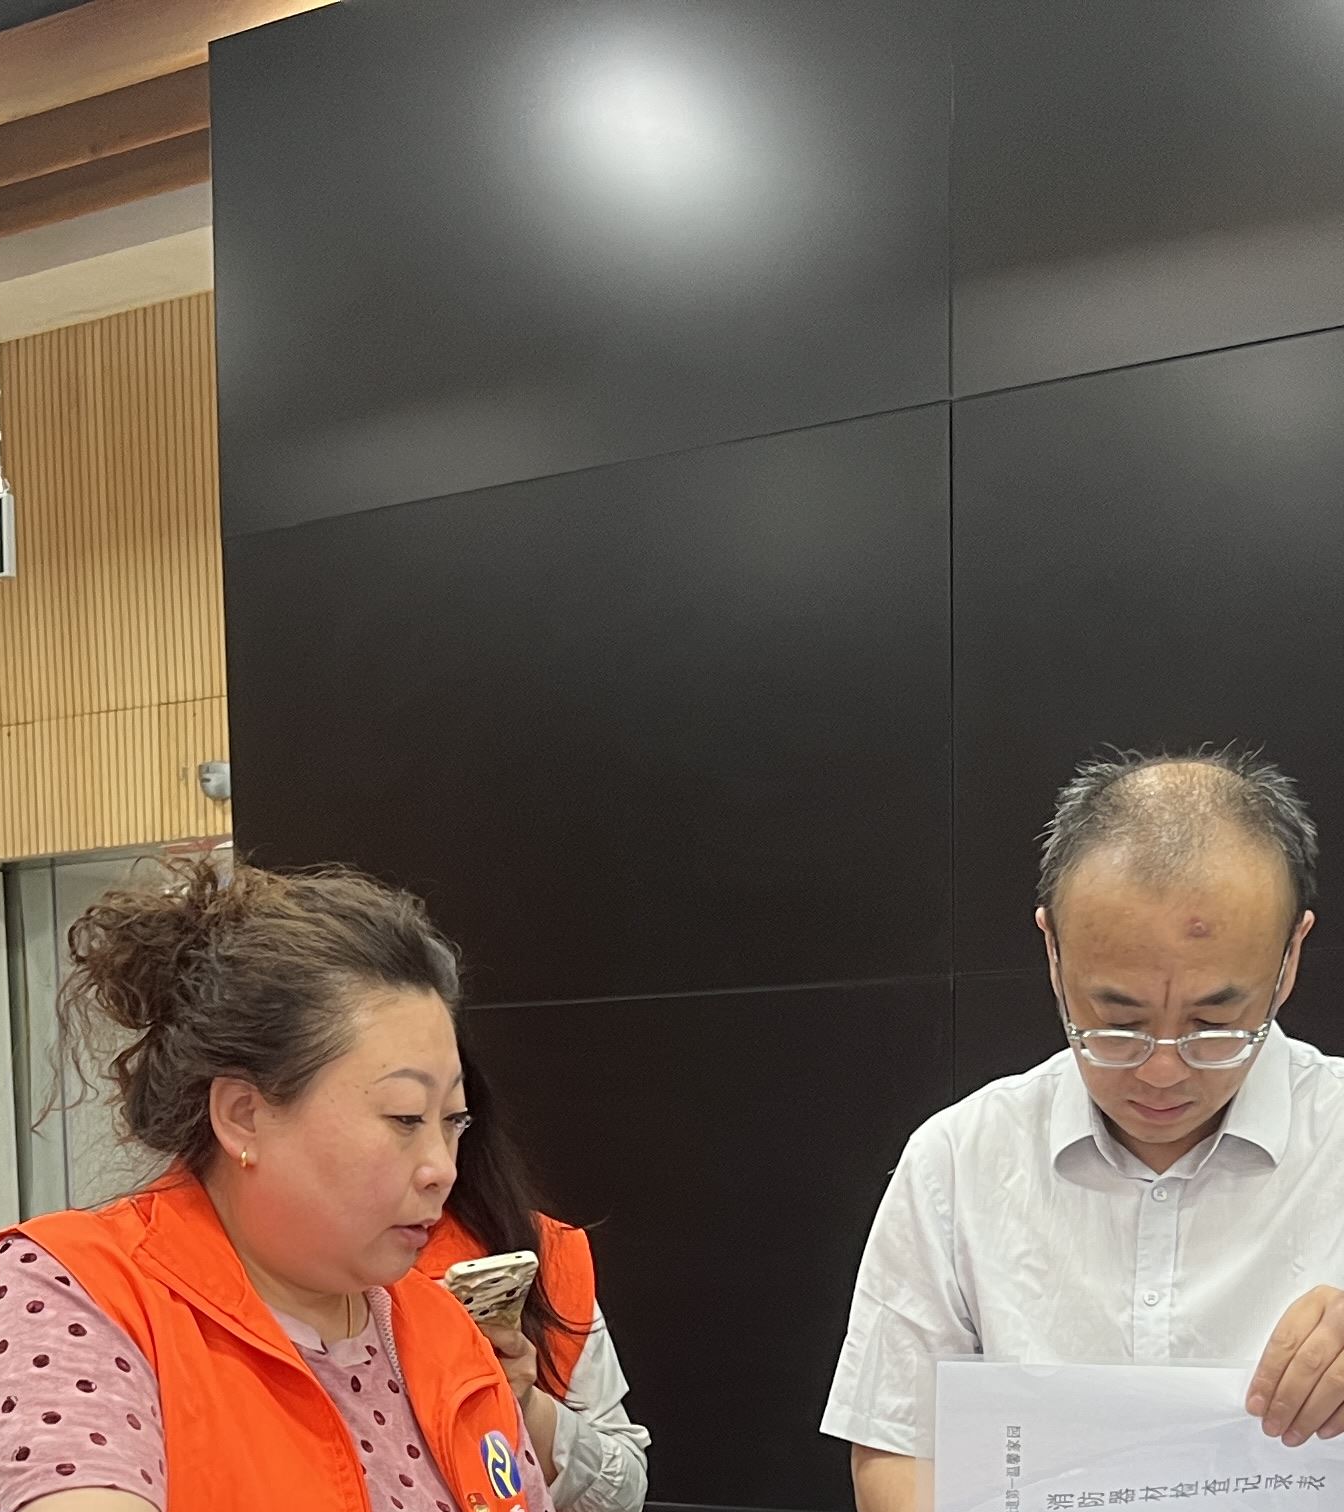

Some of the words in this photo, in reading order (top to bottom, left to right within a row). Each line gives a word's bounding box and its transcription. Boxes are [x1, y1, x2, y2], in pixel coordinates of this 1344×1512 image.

[1046, 1474, 1327, 1512] 消防器材检查记录表
